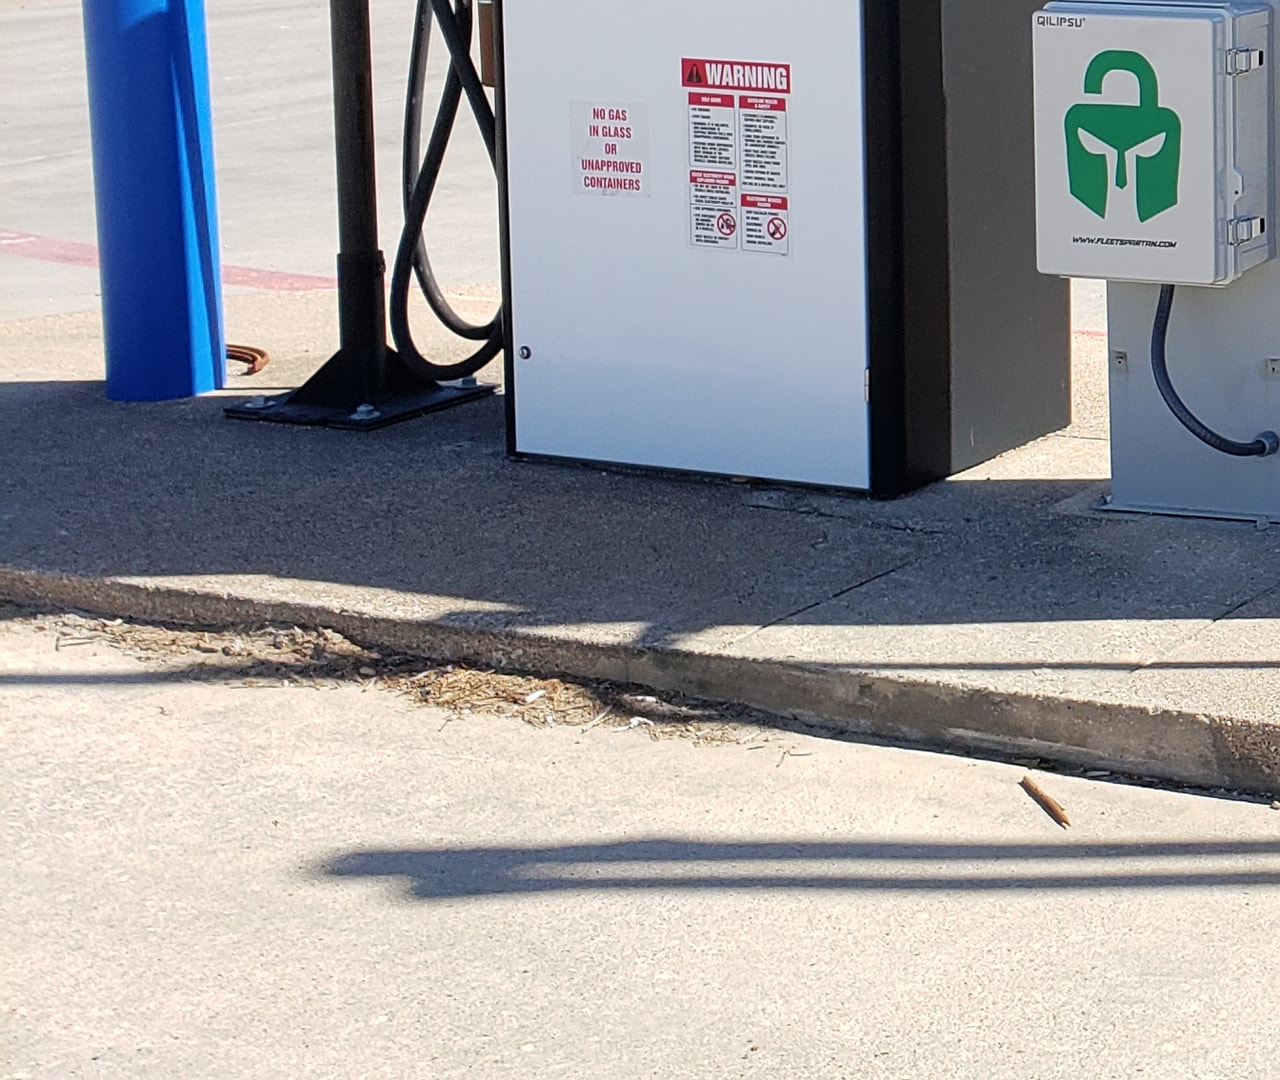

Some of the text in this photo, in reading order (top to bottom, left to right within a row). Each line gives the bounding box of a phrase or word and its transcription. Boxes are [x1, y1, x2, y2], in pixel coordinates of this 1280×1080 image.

[1037, 16, 1082, 27] QILIPSU
[705, 63, 788, 90] WARNING
[593, 108, 627, 121] NO GAS
[589, 125, 632, 138] IN GLASS
[605, 143, 617, 154] OR
[581, 159, 642, 174] UNAPPROVED
[584, 176, 640, 191] CONTAINERS
[1072, 236, 1177, 248] WWW.FLEETSPARTAN.COM
